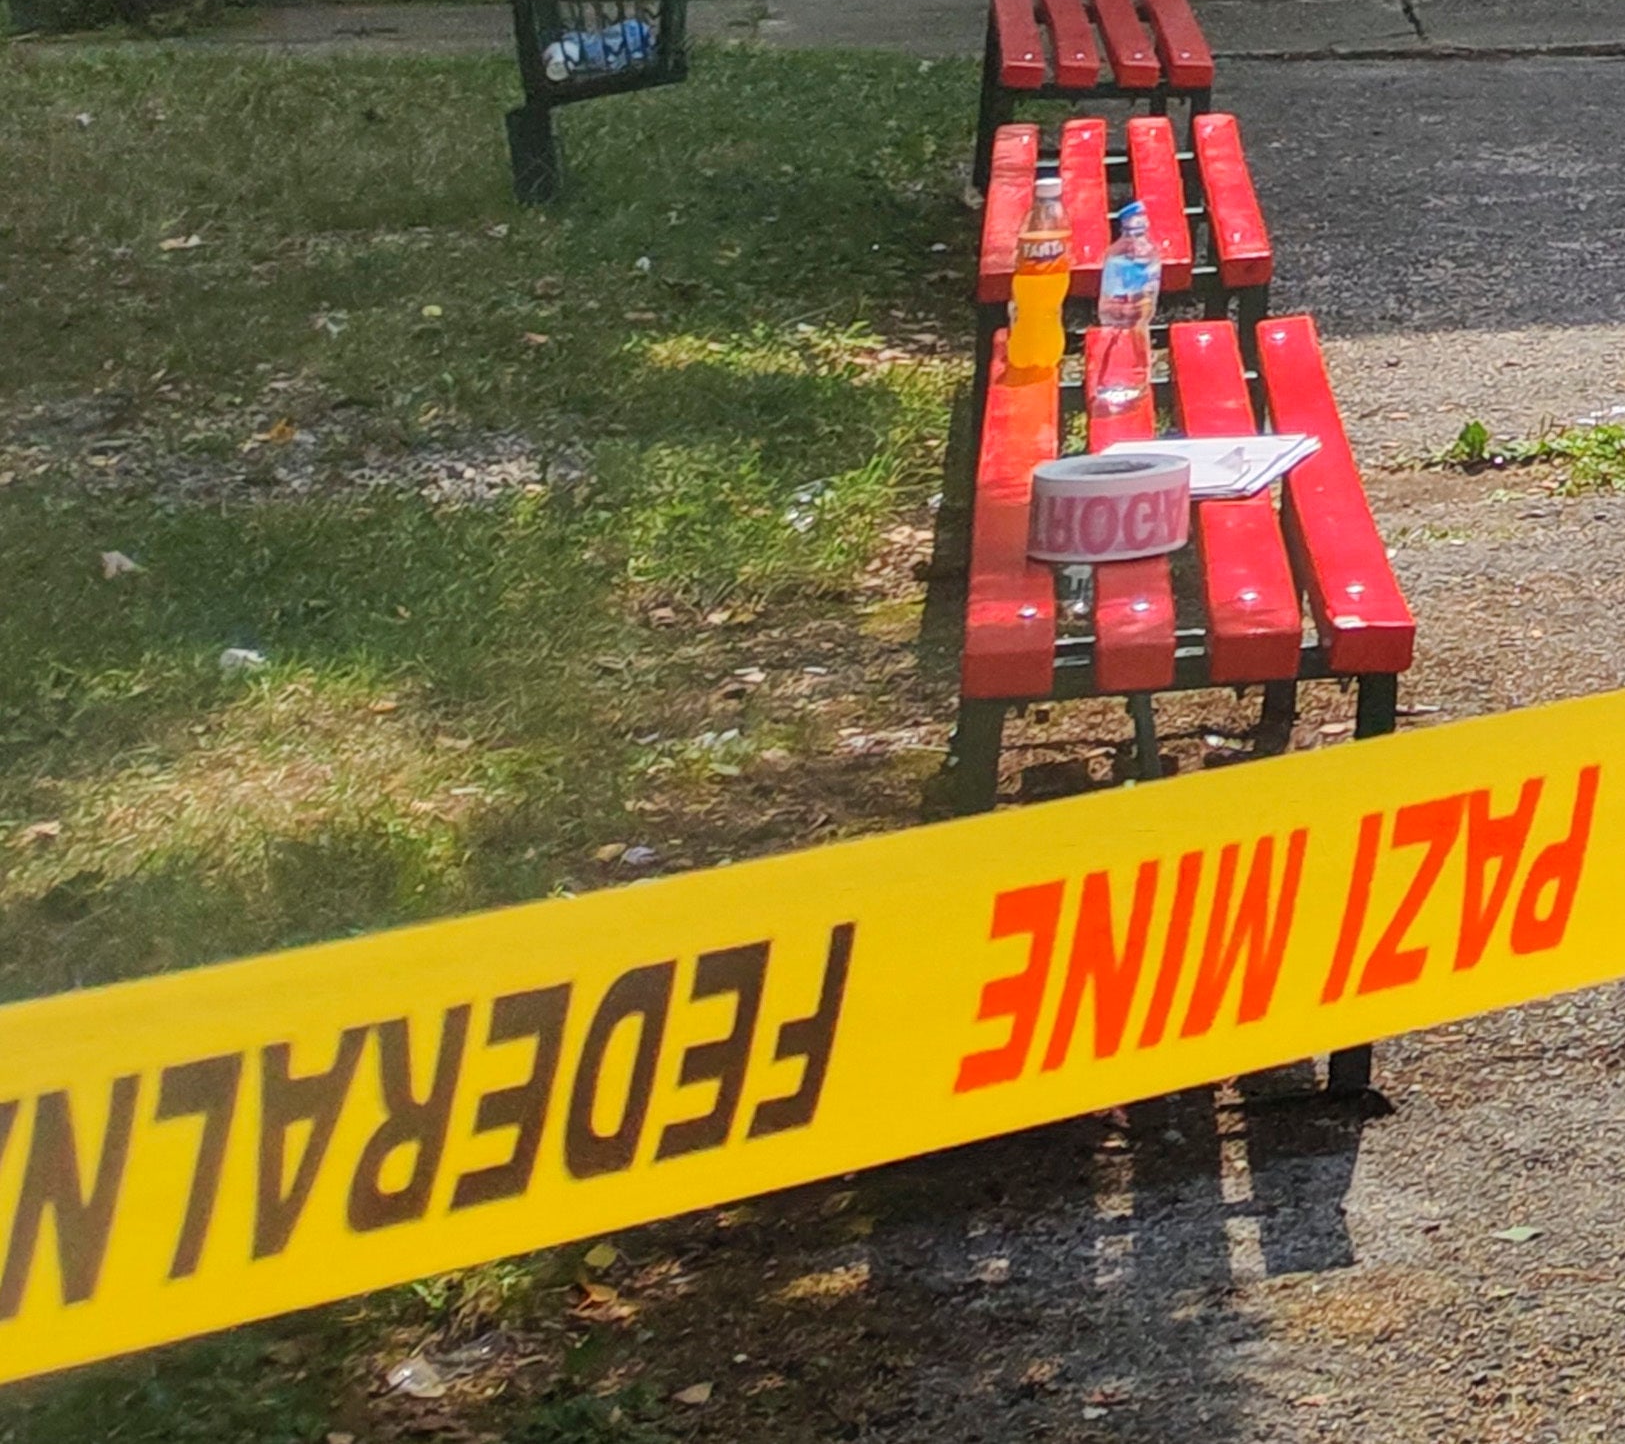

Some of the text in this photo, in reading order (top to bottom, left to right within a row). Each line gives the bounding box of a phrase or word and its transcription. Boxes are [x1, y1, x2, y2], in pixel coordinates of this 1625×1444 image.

[952, 764, 1601, 1095] PAZI MINE
[0, 922, 855, 1322] FEDERALN
